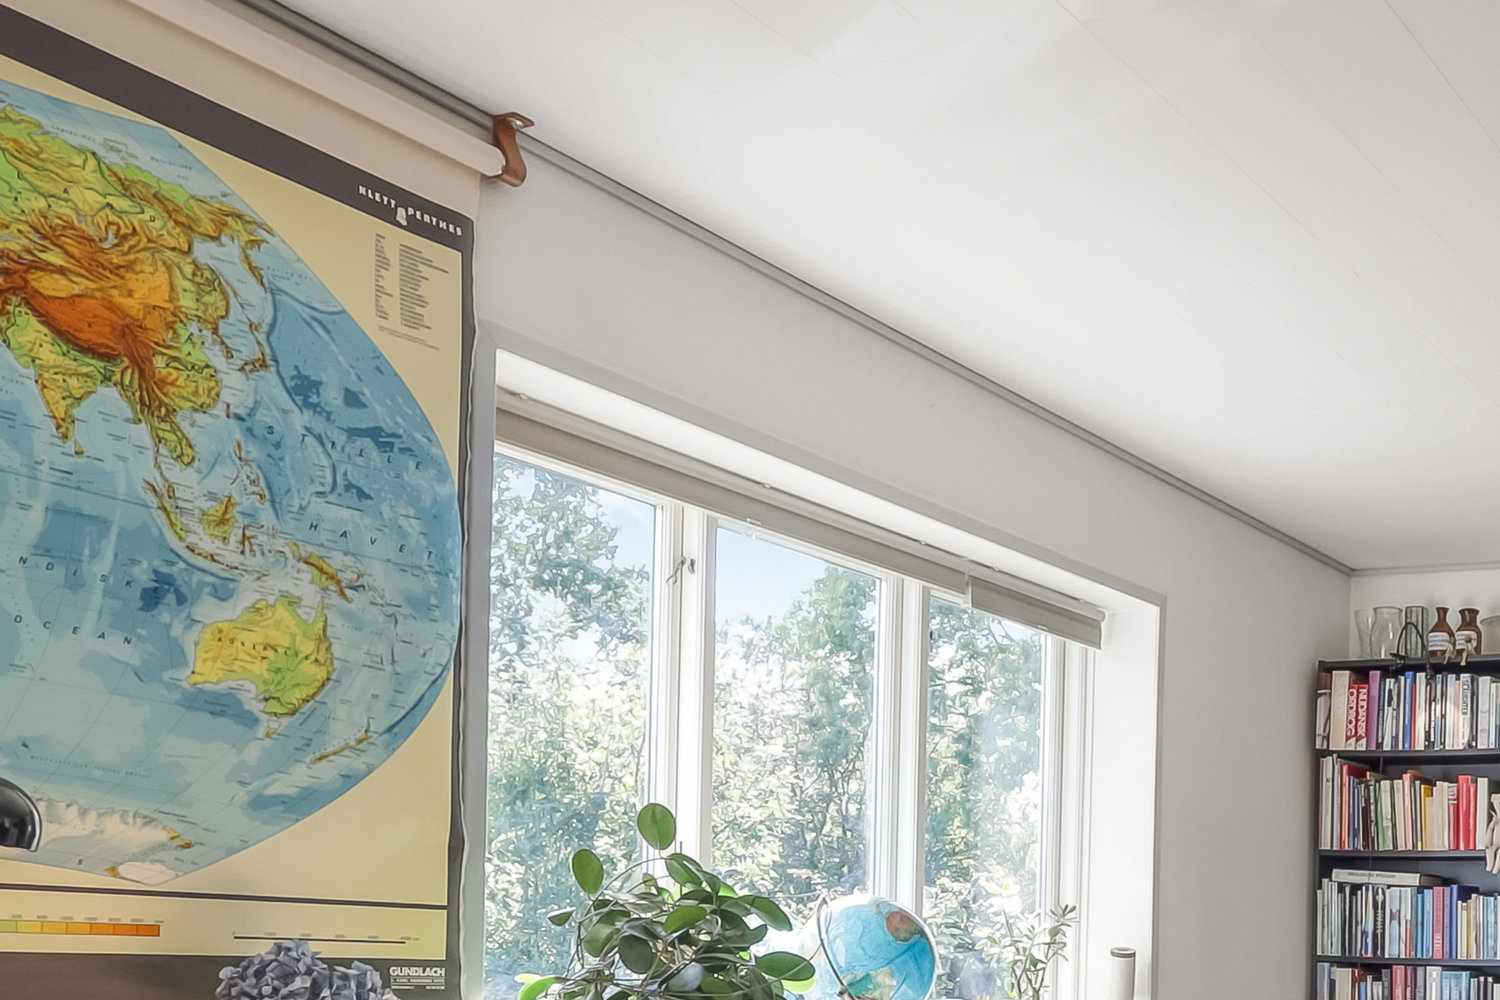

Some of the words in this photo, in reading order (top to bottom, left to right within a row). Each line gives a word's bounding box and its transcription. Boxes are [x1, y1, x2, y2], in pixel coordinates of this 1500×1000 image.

[308, 522, 435, 560] HAVET
[14, 614, 132, 646] OCEAN
[1347, 688, 1356, 736] ORDBOG
[1357, 688, 1367, 736] NUDANSK
[389, 966, 445, 977] GUNDLACH
